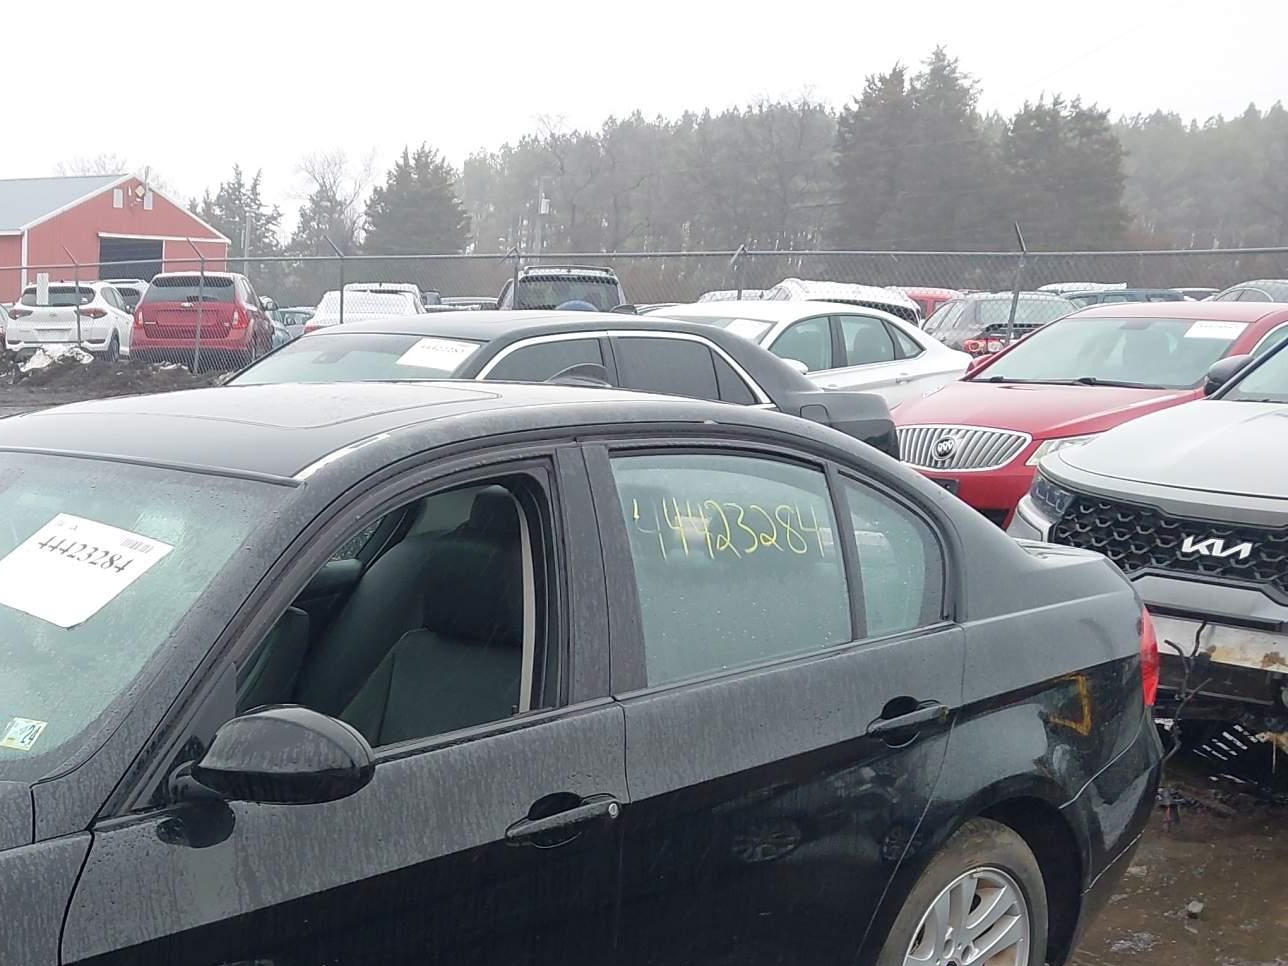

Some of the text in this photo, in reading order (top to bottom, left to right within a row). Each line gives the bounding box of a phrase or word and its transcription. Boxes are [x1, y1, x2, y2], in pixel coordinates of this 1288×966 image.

[632, 496, 825, 560] 44423284
[1181, 535, 1253, 559] KIA
[38, 535, 133, 573] 44423284
